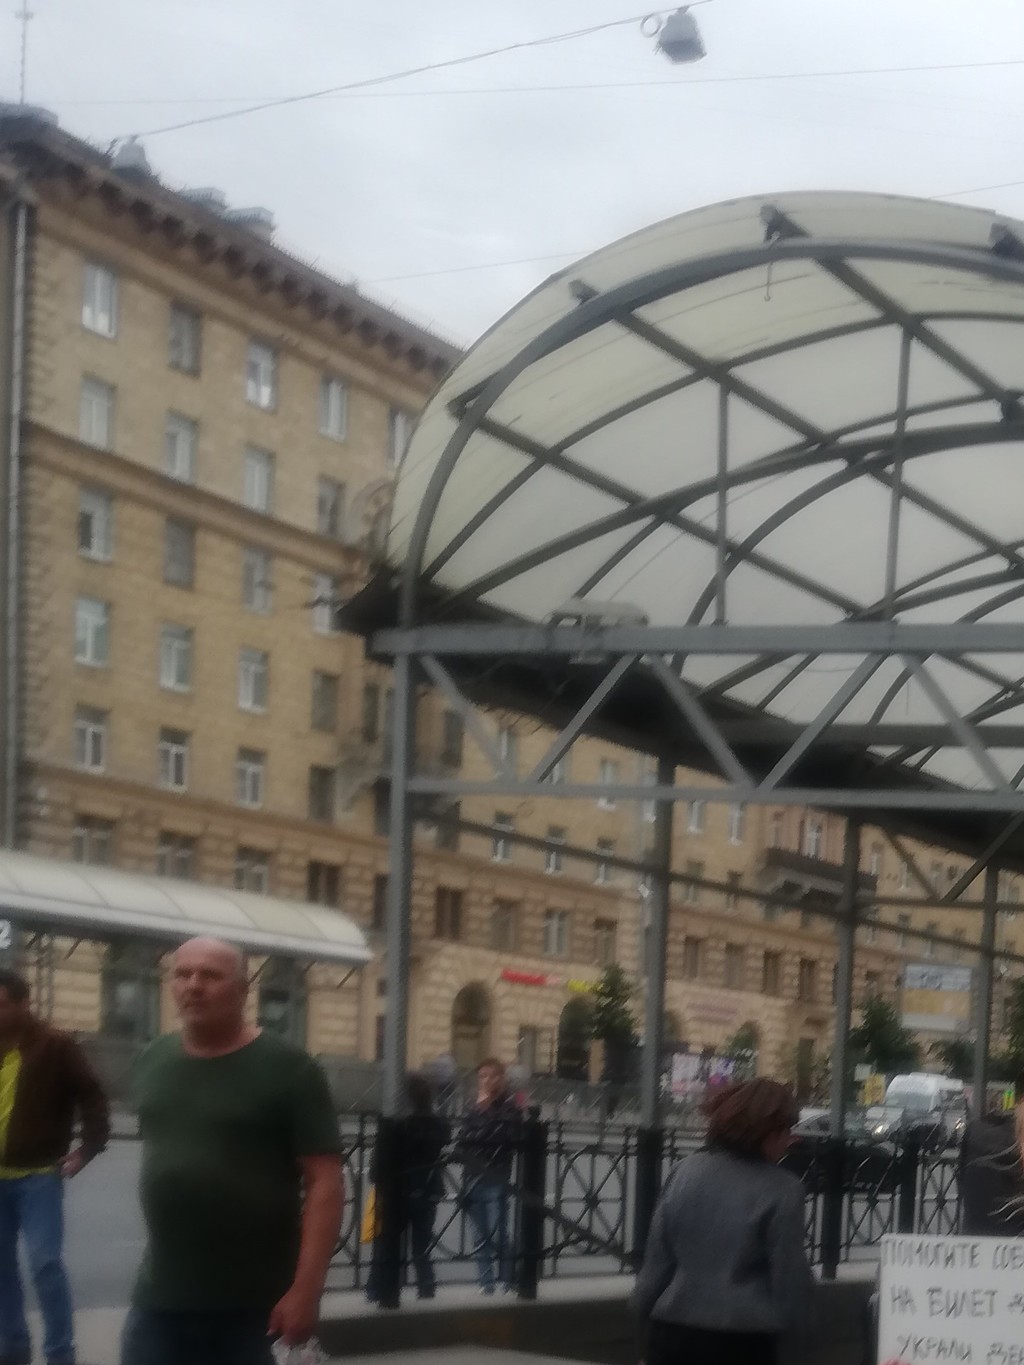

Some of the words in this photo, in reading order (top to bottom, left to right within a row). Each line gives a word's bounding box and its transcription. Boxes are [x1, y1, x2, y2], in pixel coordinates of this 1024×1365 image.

[883, 1239, 981, 1270] ПОМОГИТЕ
[890, 1285, 918, 1316] НА
[926, 1287, 998, 1319] БИЛЕТ
[897, 1333, 973, 1362] УКРАЛИ
